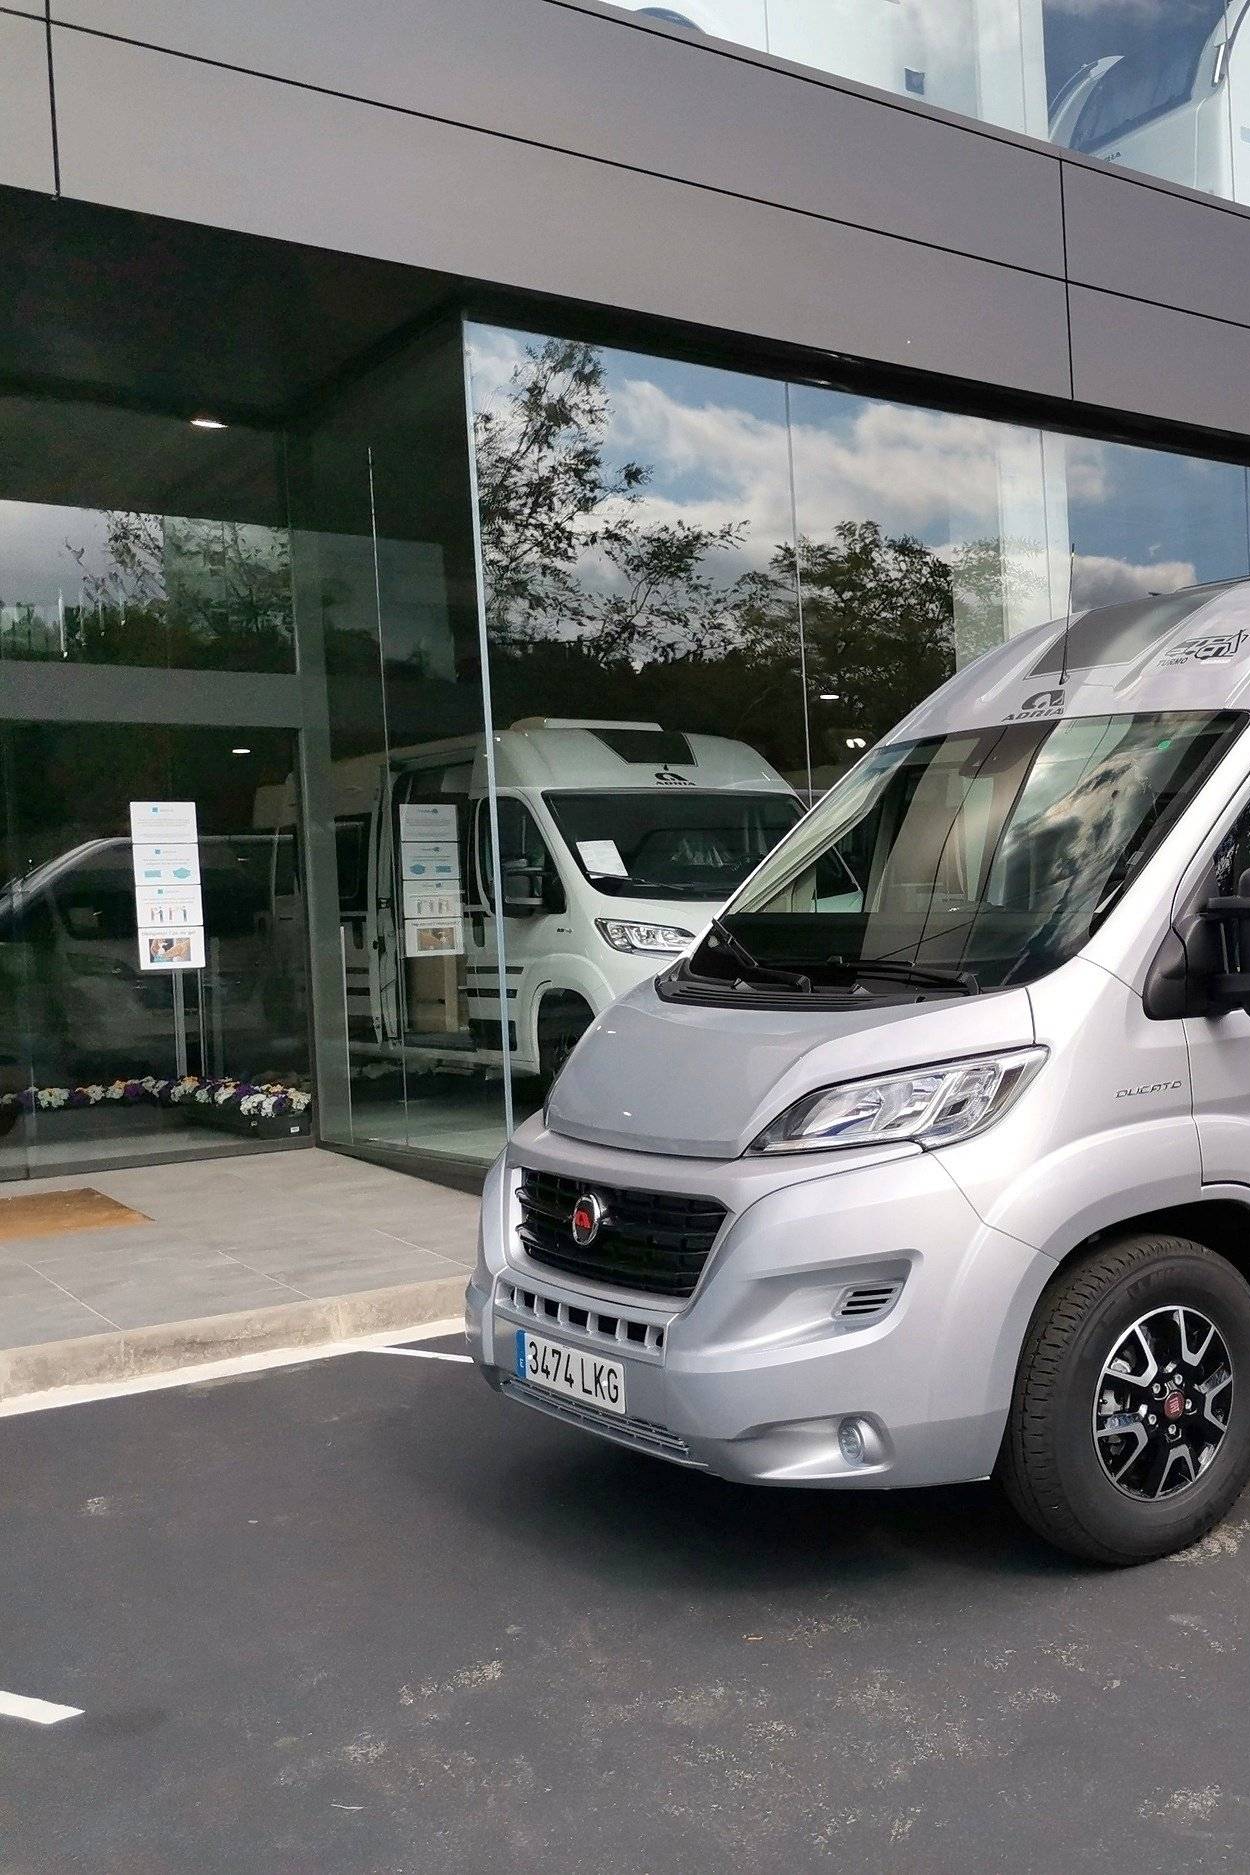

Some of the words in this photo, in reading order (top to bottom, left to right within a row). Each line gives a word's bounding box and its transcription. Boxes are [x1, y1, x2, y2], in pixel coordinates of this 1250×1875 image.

[1000, 707, 1064, 722] ADRIA
[1115, 1080, 1182, 1098] DUCATO
[529, 1340, 574, 1389] 3474
[581, 1357, 619, 1404] LKG
